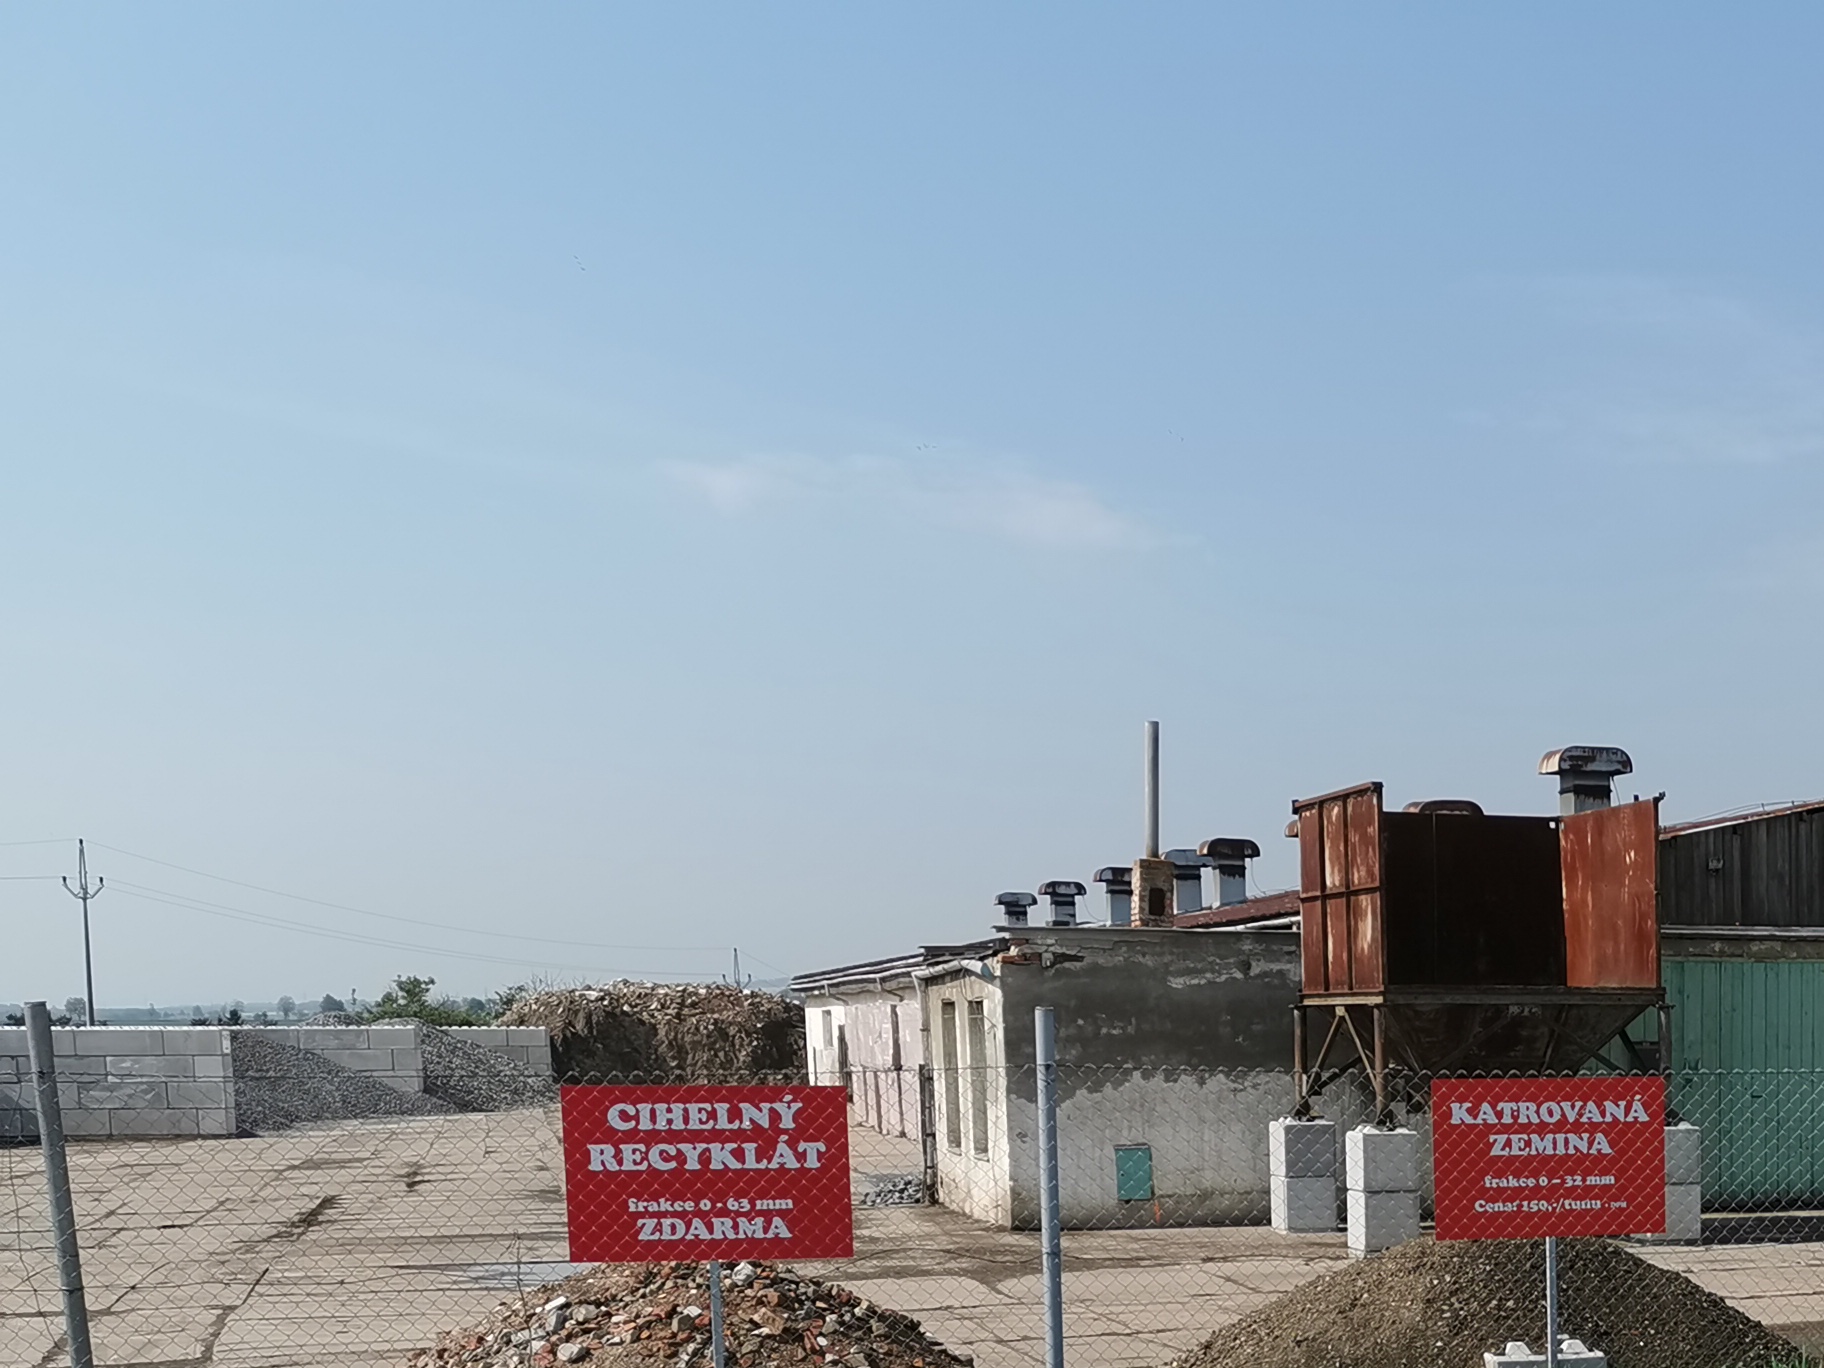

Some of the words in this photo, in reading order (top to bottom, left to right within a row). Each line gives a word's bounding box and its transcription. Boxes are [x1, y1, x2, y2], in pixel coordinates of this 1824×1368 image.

[607, 1094, 803, 1131] CIHELNÝ
[1450, 1095, 1650, 1125] KATROVANÁ
[587, 1135, 826, 1171] RECYKLÁT
[1489, 1133, 1613, 1156] ZEMINA
[1484, 1175, 1536, 1188] frakce
[1538, 1176, 1549, 1187] 0
[1564, 1175, 1583, 1188] 32
[1586, 1175, 1616, 1185] mm
[628, 1197, 695, 1212] frakce
[699, 1199, 712, 1211] 0
[726, 1197, 751, 1211] 63
[755, 1198, 794, 1210] mm
[636, 1216, 793, 1241] ZDARMA
